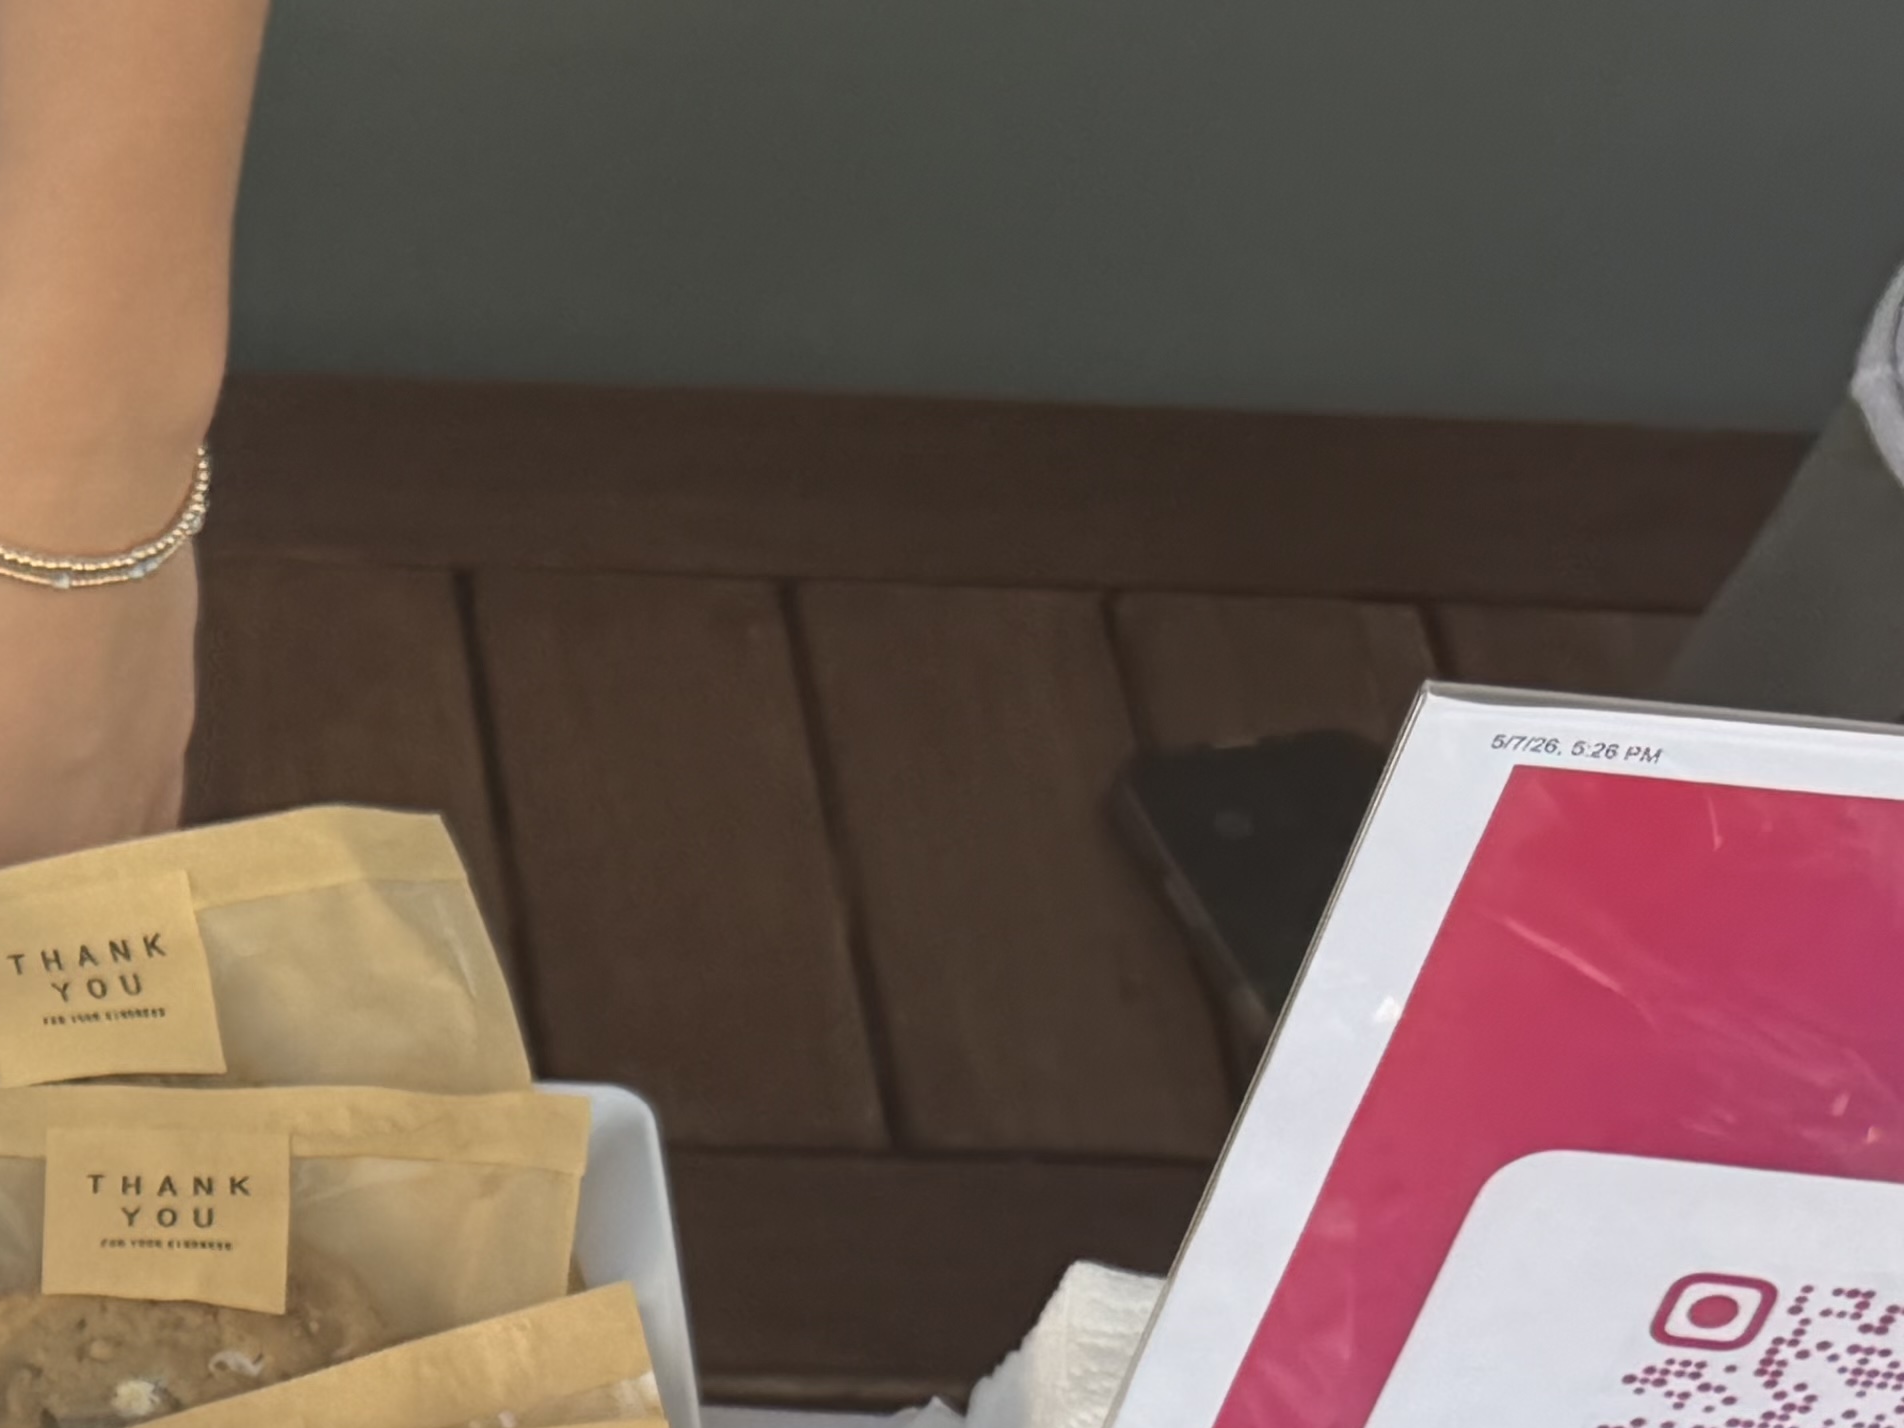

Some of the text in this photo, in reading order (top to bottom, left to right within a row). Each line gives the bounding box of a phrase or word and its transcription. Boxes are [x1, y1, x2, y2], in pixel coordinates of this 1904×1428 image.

[1571, 740, 1620, 760] 5:26
[1624, 746, 1663, 765] PM
[7, 933, 166, 976] THANK
[51, 973, 143, 1003] YOU
[86, 1174, 251, 1197] THANK
[121, 1207, 214, 1228] YOU
